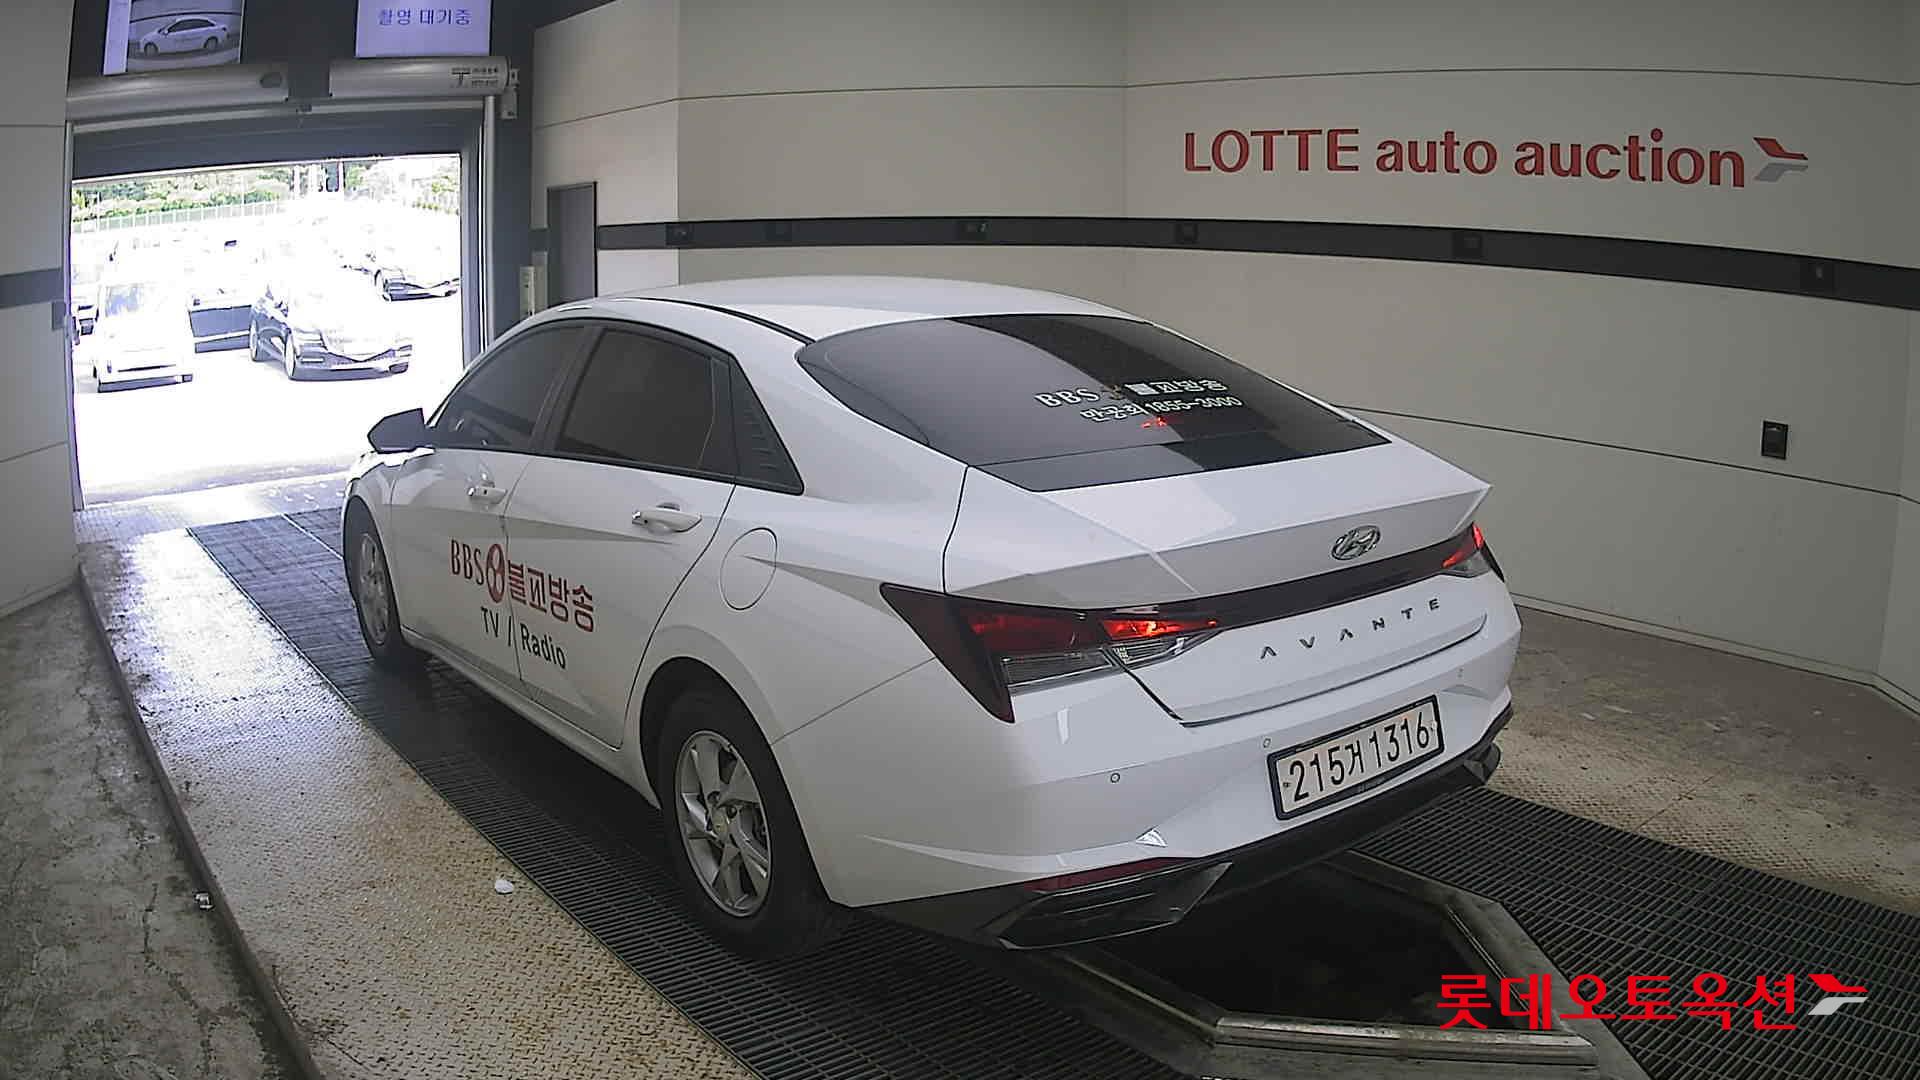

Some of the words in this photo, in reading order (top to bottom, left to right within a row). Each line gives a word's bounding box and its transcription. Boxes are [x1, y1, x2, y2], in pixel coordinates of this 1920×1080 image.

[420, 8, 470, 26] 대기중
[1184, 128, 1360, 173] LOTTE
[1375, 130, 1498, 175] auto
[1514, 127, 1745, 188] auction
[1035, 388, 1100, 407] BBS
[450, 539, 485, 586] BBS
[507, 559, 594, 633] 불교방송
[480, 605, 500, 638] TV
[519, 622, 567, 670] Radio
[1259, 597, 1441, 661] AVANTE
